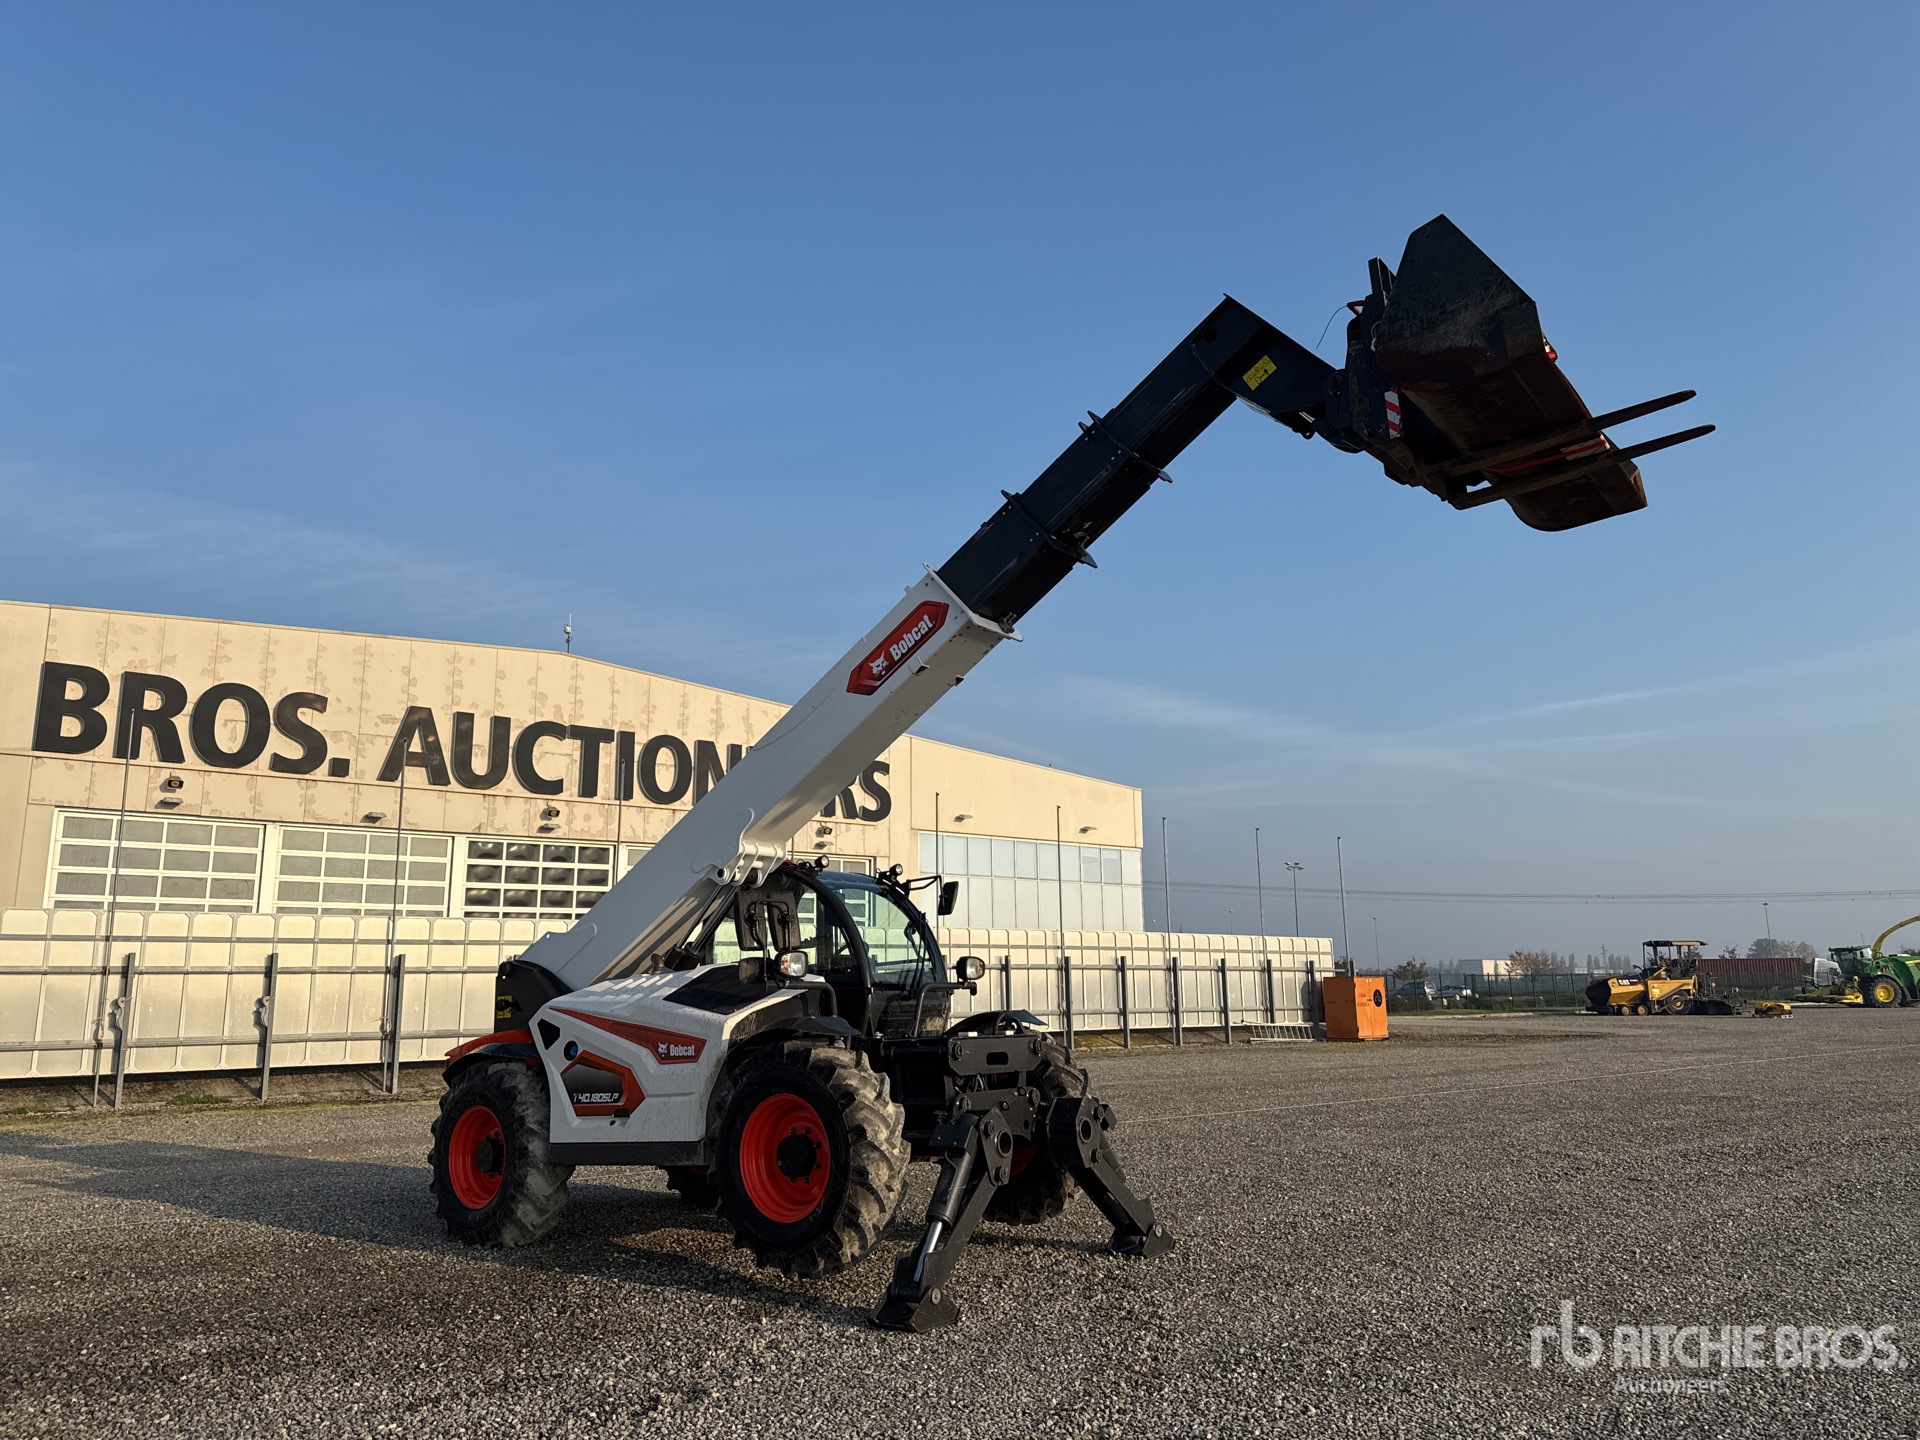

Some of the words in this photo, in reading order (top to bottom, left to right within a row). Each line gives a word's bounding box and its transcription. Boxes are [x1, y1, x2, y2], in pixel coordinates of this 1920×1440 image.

[889, 614, 934, 661] Bobcat
[32, 660, 351, 778] BROS.
[376, 705, 893, 822] AUCTIONS
[669, 1044, 695, 1056] Bobcat
